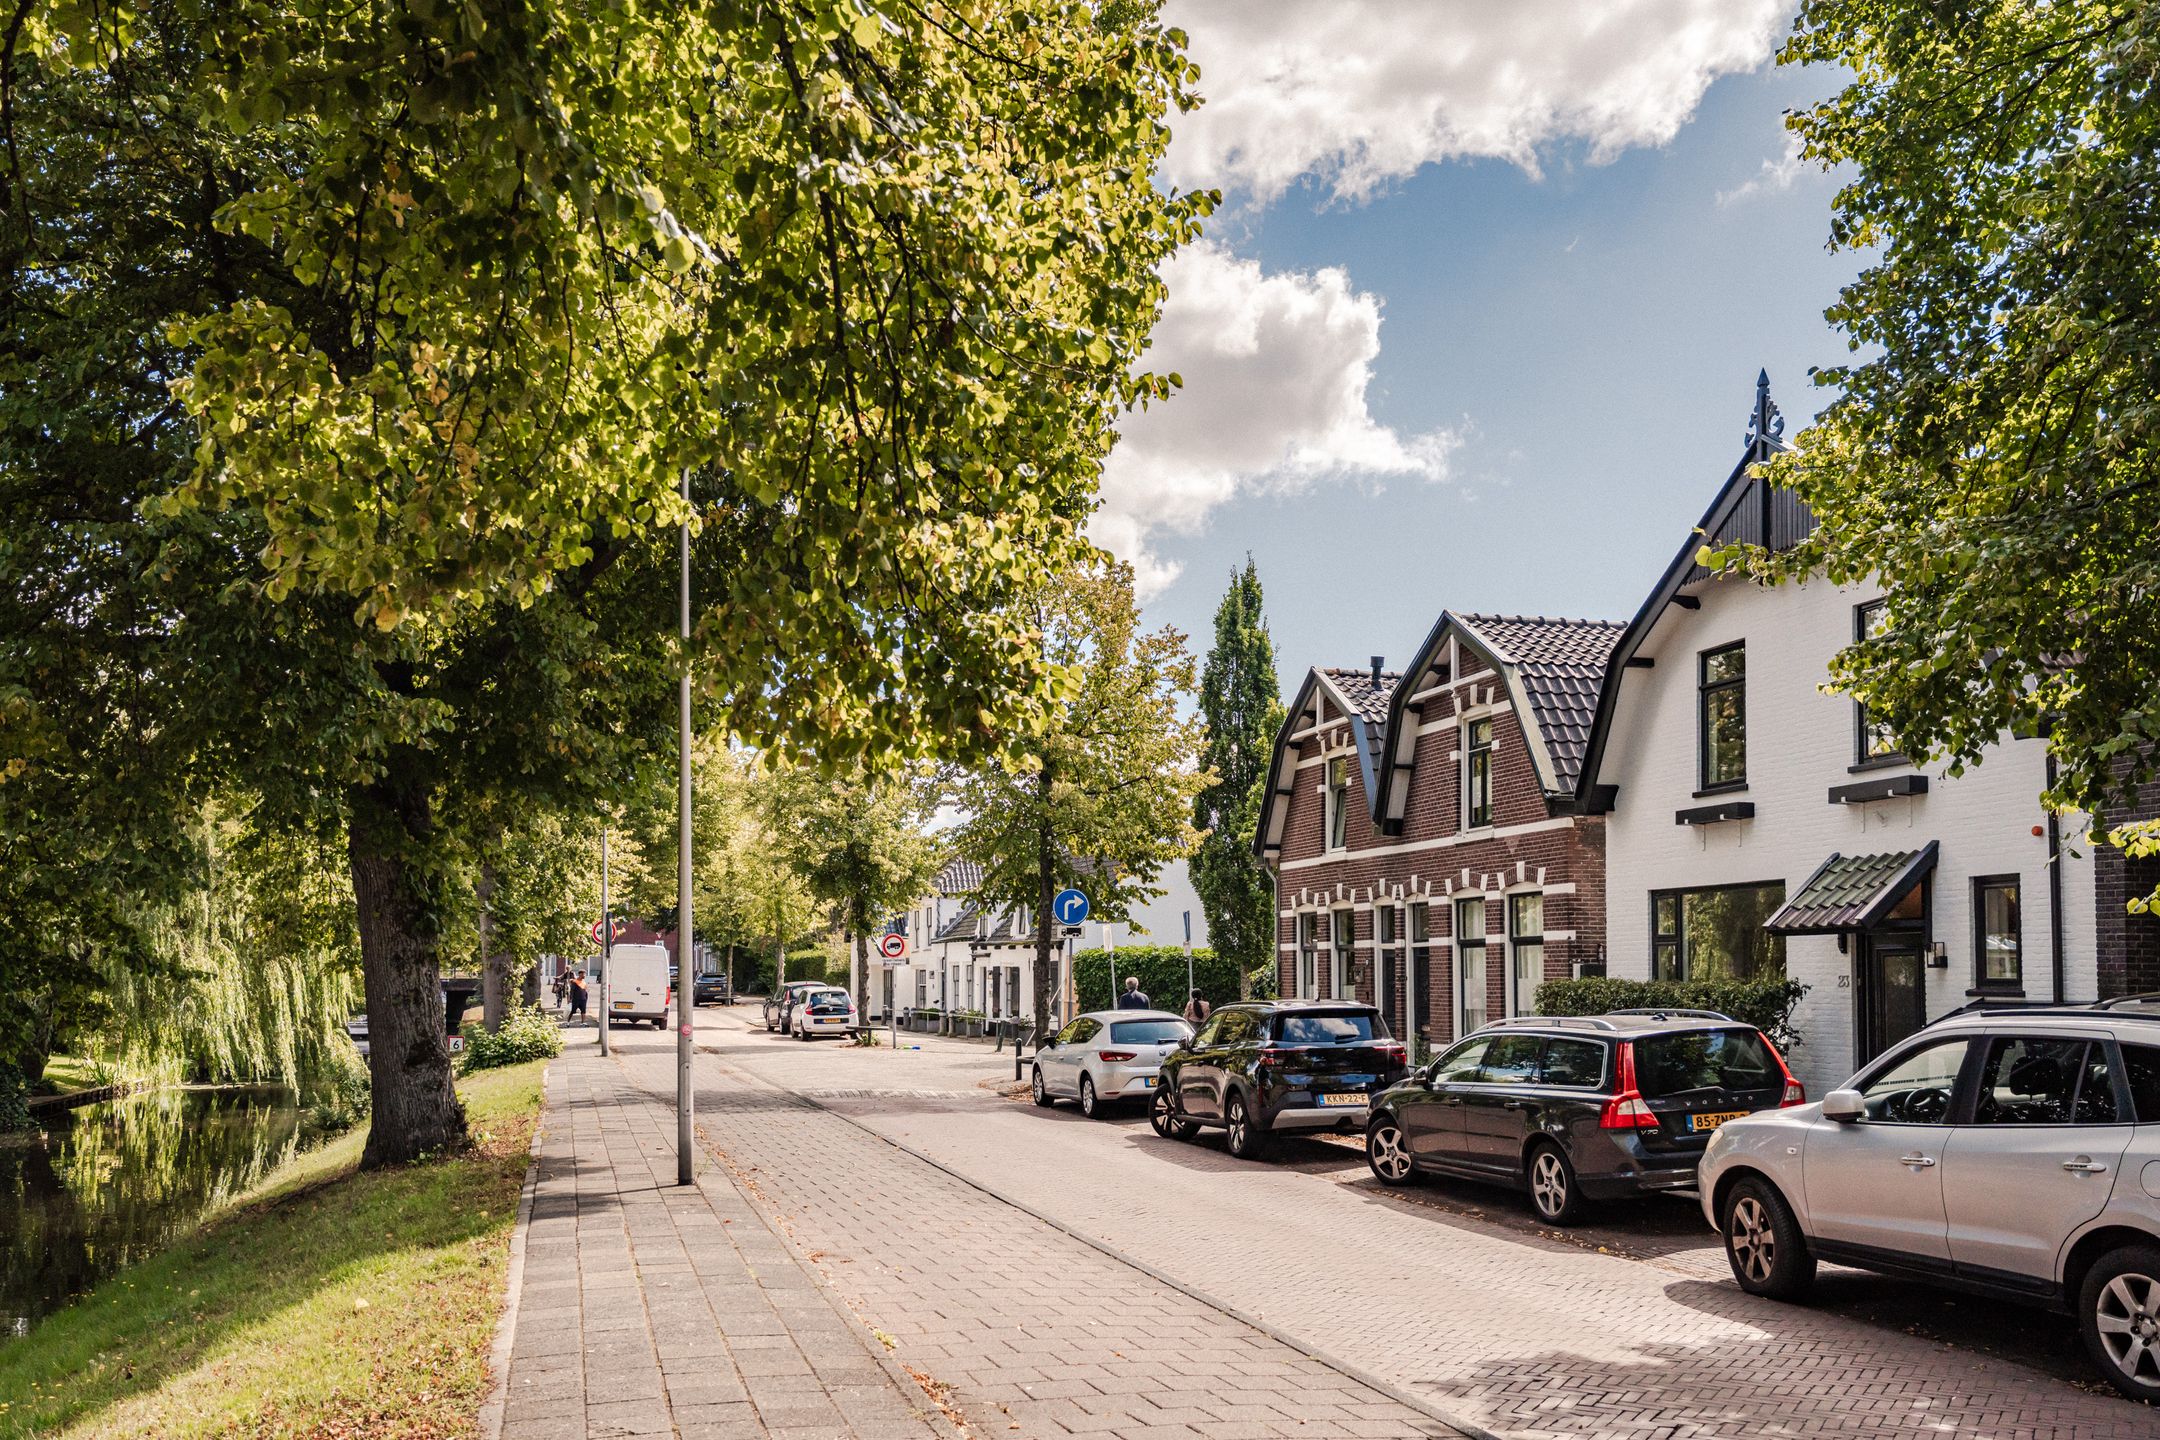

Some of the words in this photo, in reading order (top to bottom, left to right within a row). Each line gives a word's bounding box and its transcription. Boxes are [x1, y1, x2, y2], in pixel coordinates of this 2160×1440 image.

[1838, 975, 1849, 987] 23
[453, 1040, 459, 1049] 6
[1326, 1094, 1366, 1103] KKN-22-F
[1696, 1113, 1746, 1127] 85-ZN-
